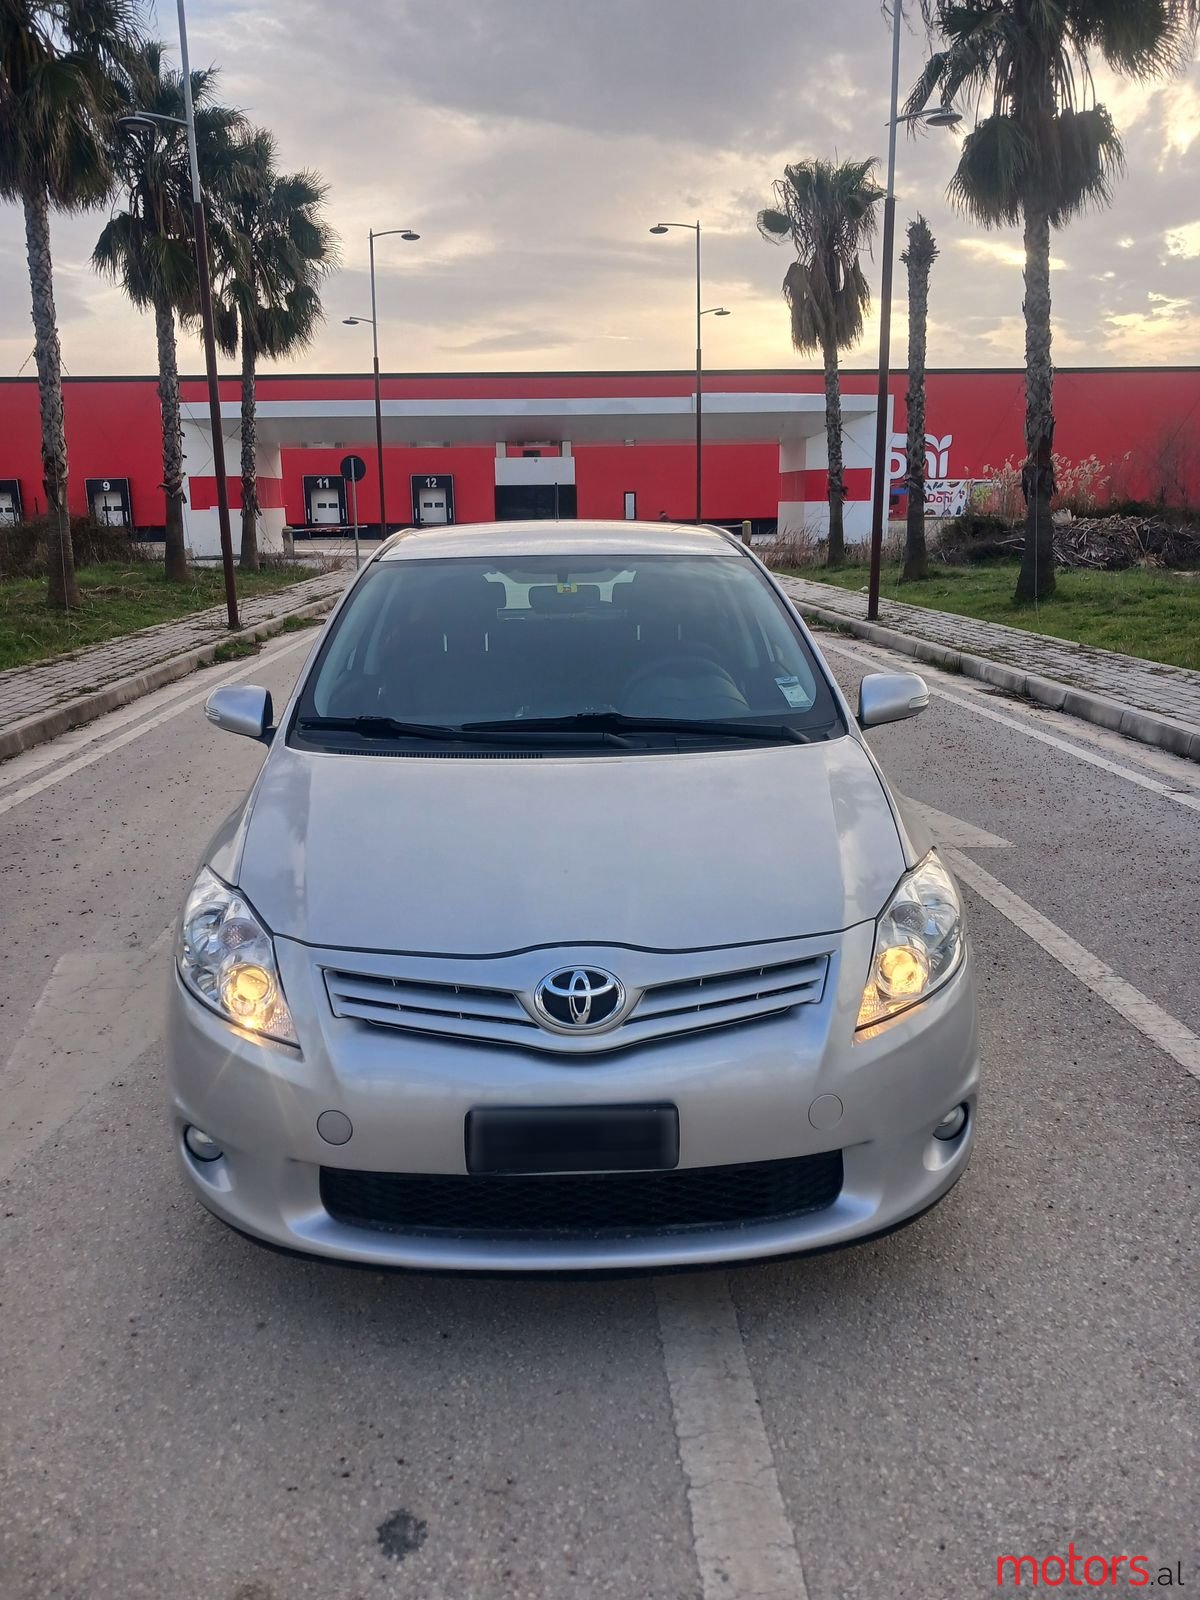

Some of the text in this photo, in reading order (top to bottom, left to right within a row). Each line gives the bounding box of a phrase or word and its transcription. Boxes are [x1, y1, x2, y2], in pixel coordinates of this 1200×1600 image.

[102, 481, 110, 491] 9
[316, 478, 330, 489] 11
[425, 477, 437, 488] 12
